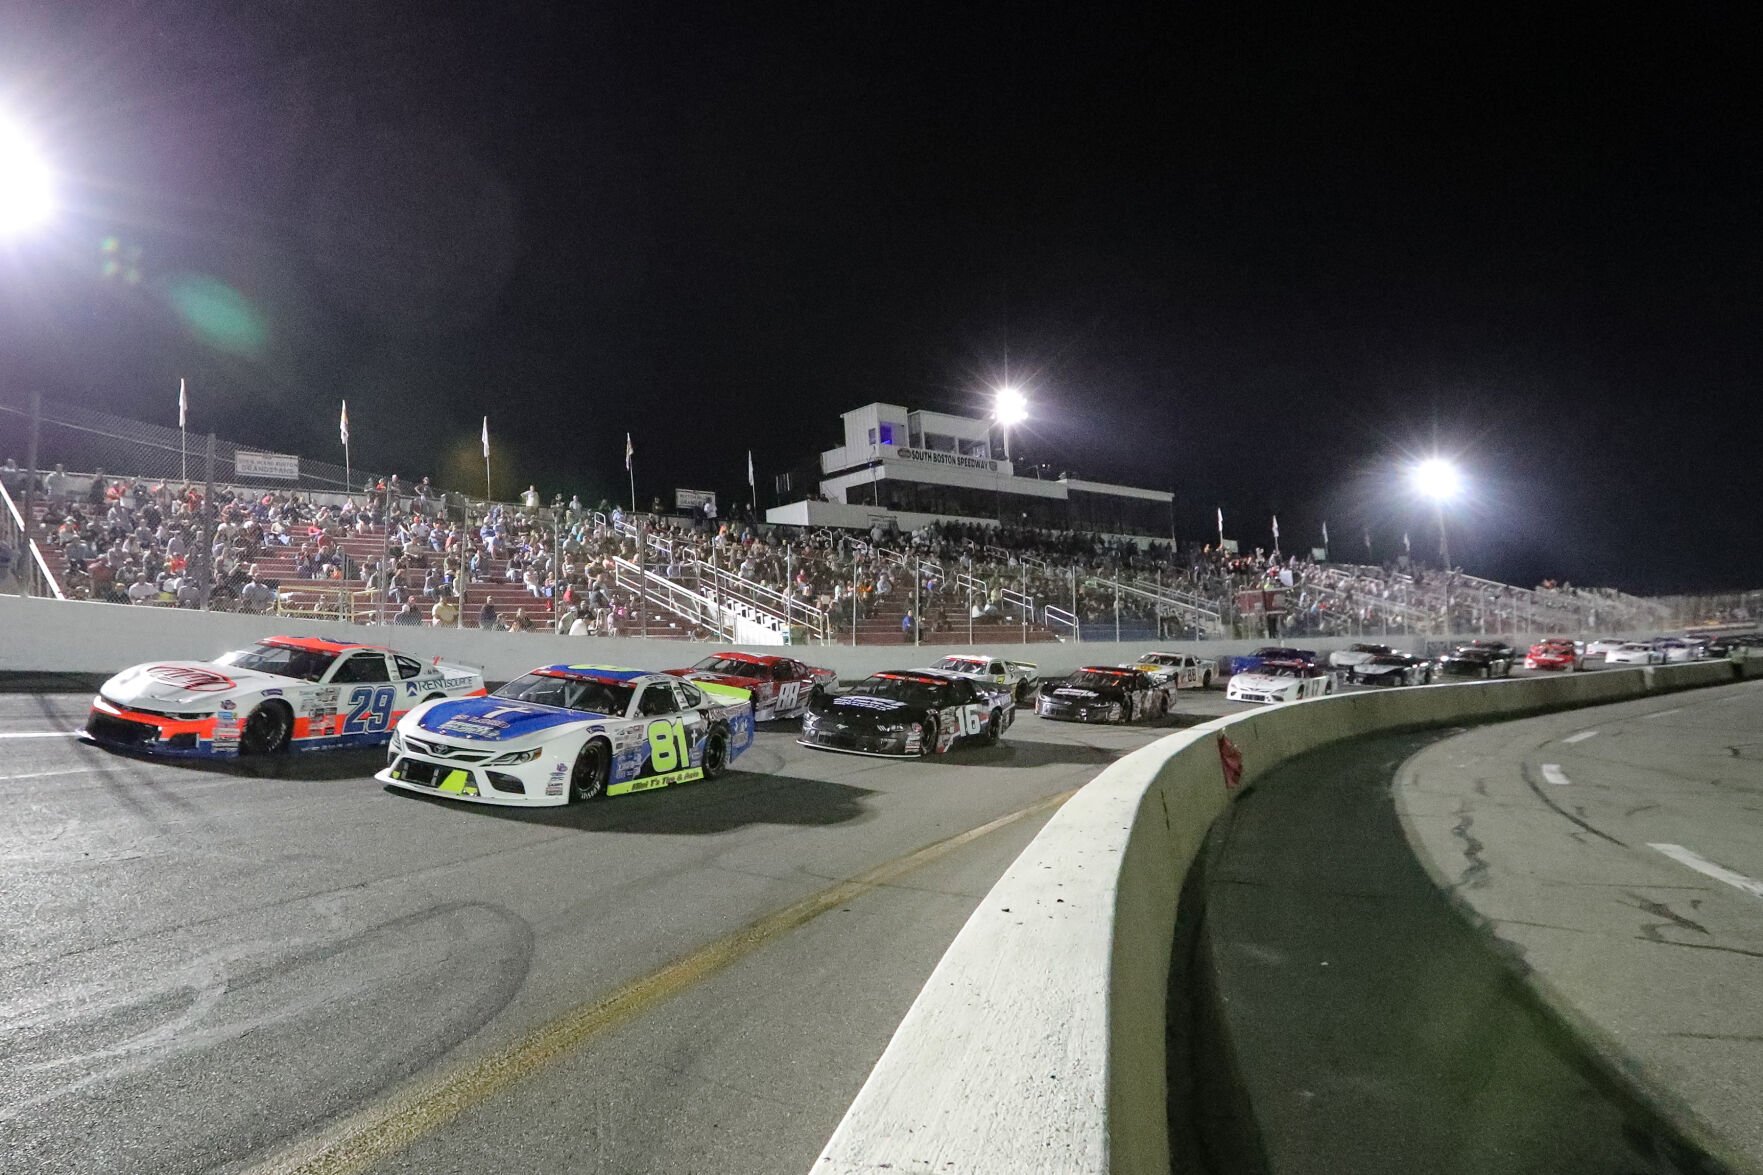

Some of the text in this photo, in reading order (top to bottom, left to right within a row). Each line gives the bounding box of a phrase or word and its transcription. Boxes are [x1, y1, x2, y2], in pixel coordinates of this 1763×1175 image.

[911, 449, 989, 470] SOUTH BOSTON SPEEDWAY
[342, 686, 396, 734] 29
[774, 681, 801, 711] 88
[955, 703, 981, 737] 16
[647, 716, 690, 773] 81
